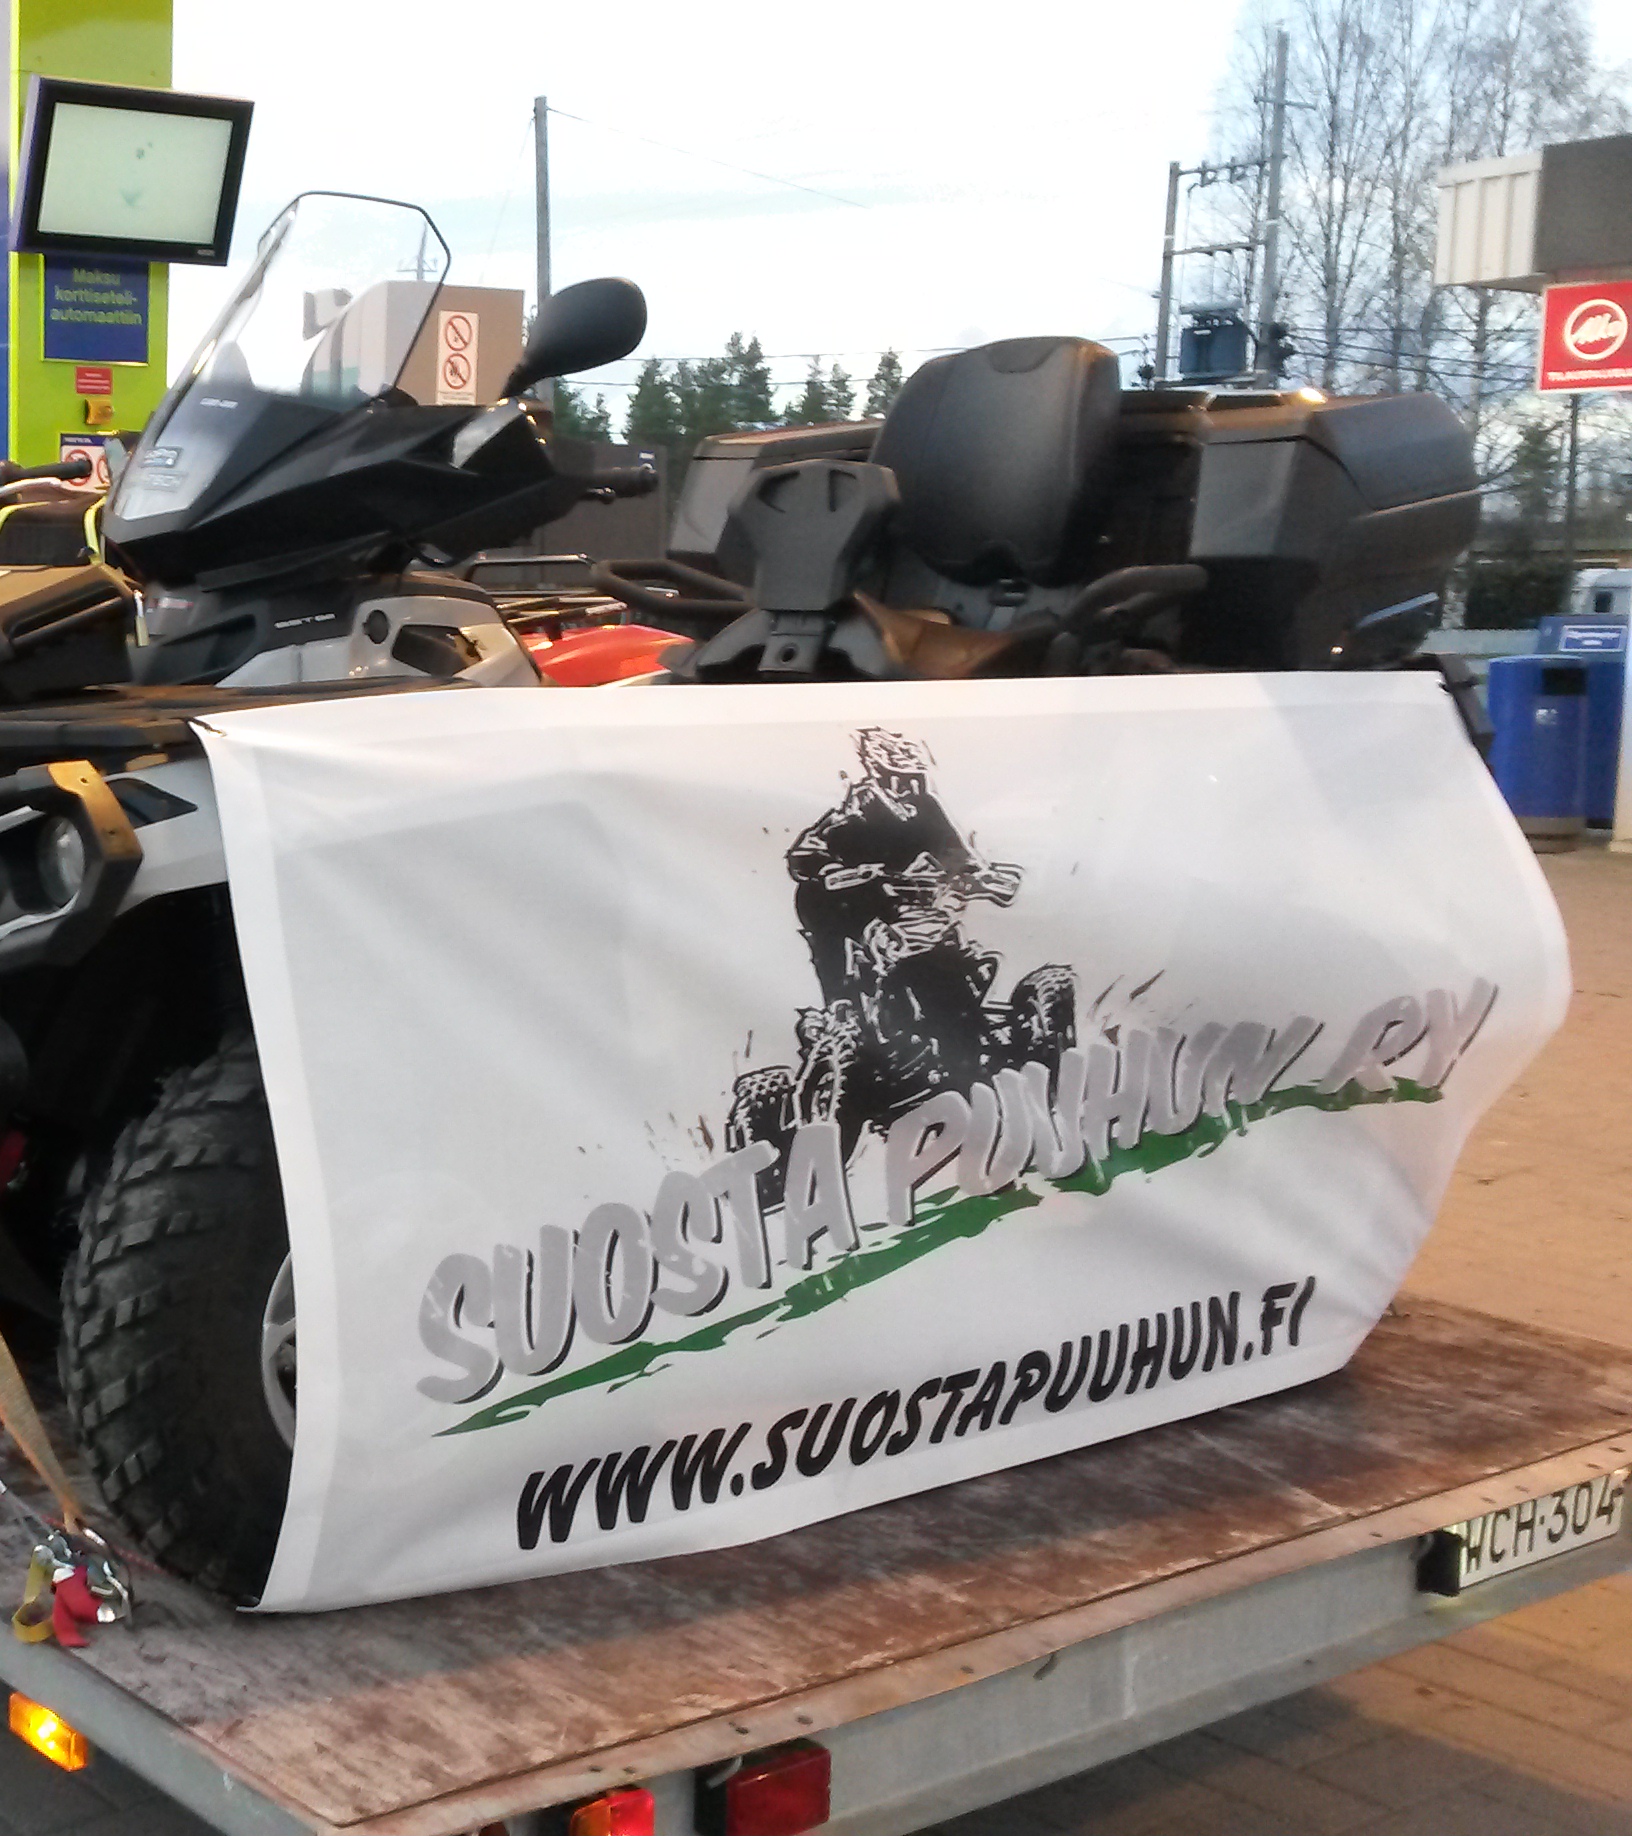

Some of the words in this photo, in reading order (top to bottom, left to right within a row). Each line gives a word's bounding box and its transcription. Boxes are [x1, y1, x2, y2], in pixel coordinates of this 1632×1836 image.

[72, 267, 121, 286] Maksu
[415, 1123, 860, 1404] SUOSTA
[886, 1015, 1324, 1227] PUUHUN
[1318, 975, 1498, 1094] RY
[515, 1276, 1317, 1551] WWW.SUOSTAPUUHUN.FI
